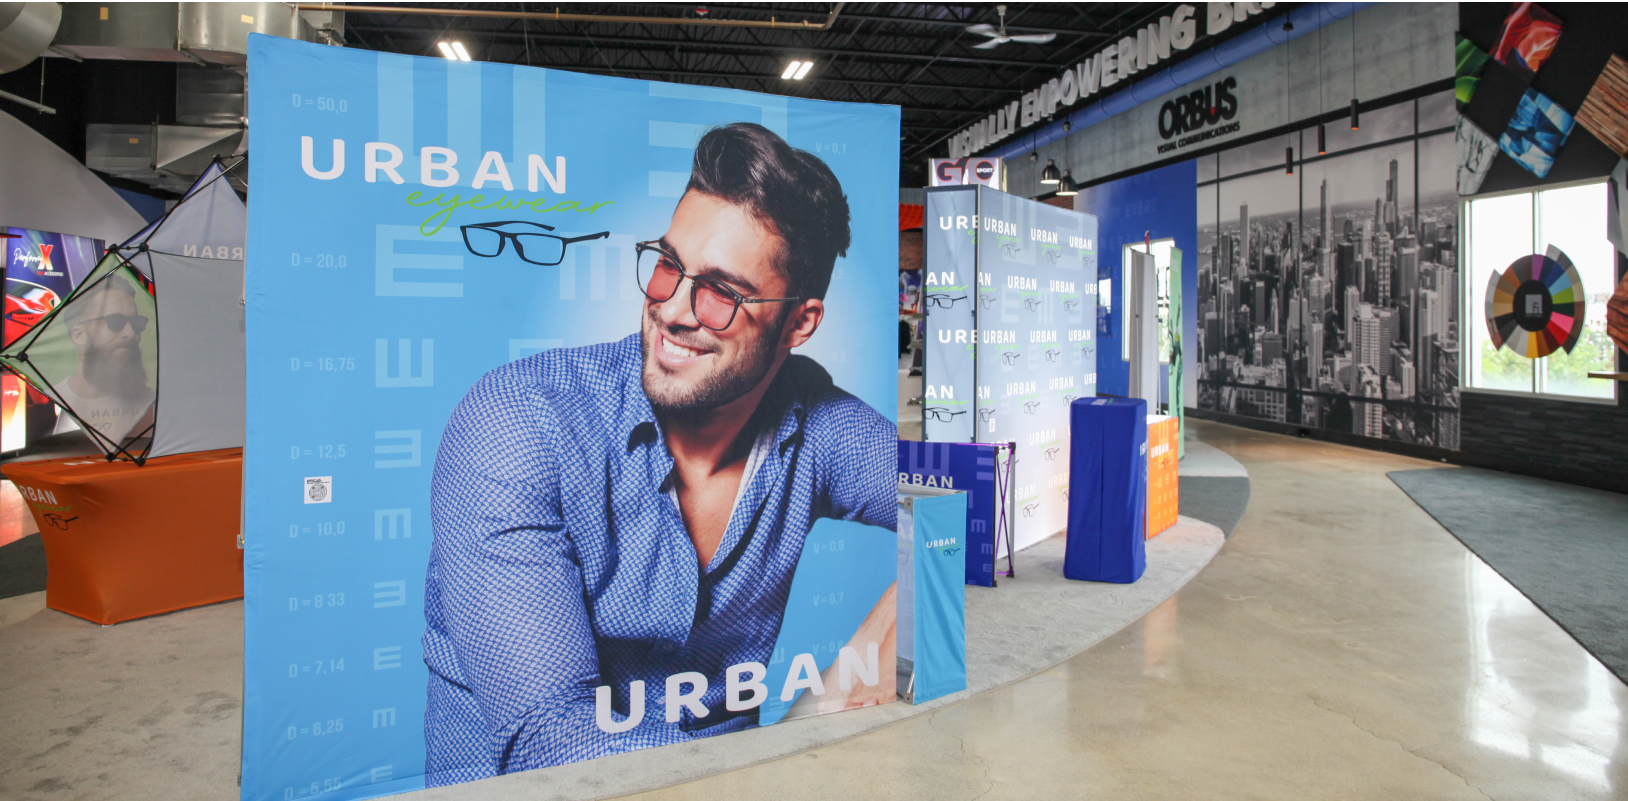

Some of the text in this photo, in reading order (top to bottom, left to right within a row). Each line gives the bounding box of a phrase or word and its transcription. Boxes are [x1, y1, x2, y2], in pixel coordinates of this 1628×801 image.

[1021, 4, 1196, 128] EMPOWERING
[292, 94, 301, 107] D
[317, 96, 348, 113] 50,0
[1158, 76, 1238, 140] ORBUS
[1157, 121, 1241, 154] VISUAL COMMUNICATIONS
[301, 135, 567, 194] URBAN
[406, 190, 615, 236] eyewear
[984, 217, 1017, 237] URBAN
[1031, 228, 1058, 244] URBAN
[1069, 236, 1092, 250] URBAN
[291, 252, 300, 267] D
[316, 253, 347, 270] 20,0
[1007, 275, 1037, 291] URBAN
[1050, 280, 1075, 294] URBAN
[983, 330, 1016, 344] URBAN
[1030, 330, 1057, 343] URBAN
[1068, 329, 1091, 342] URBAN
[291, 357, 300, 371] D
[318, 357, 355, 372] 16,75
[1006, 381, 1036, 396] URBAN
[1049, 375, 1074, 390] URBAN
[1029, 428, 1056, 446] URBAN
[291, 446, 300, 460] D
[318, 444, 346, 460] 12,5
[1150, 442, 1169, 458] URBAN
[290, 524, 299, 538] D
[317, 521, 345, 536] 10,0
[926, 537, 956, 549] URBAN
[289, 597, 298, 611] D
[289, 664, 298, 678] D
[595, 642, 880, 734] URBAN
[313, 718, 344, 737] 6,25
